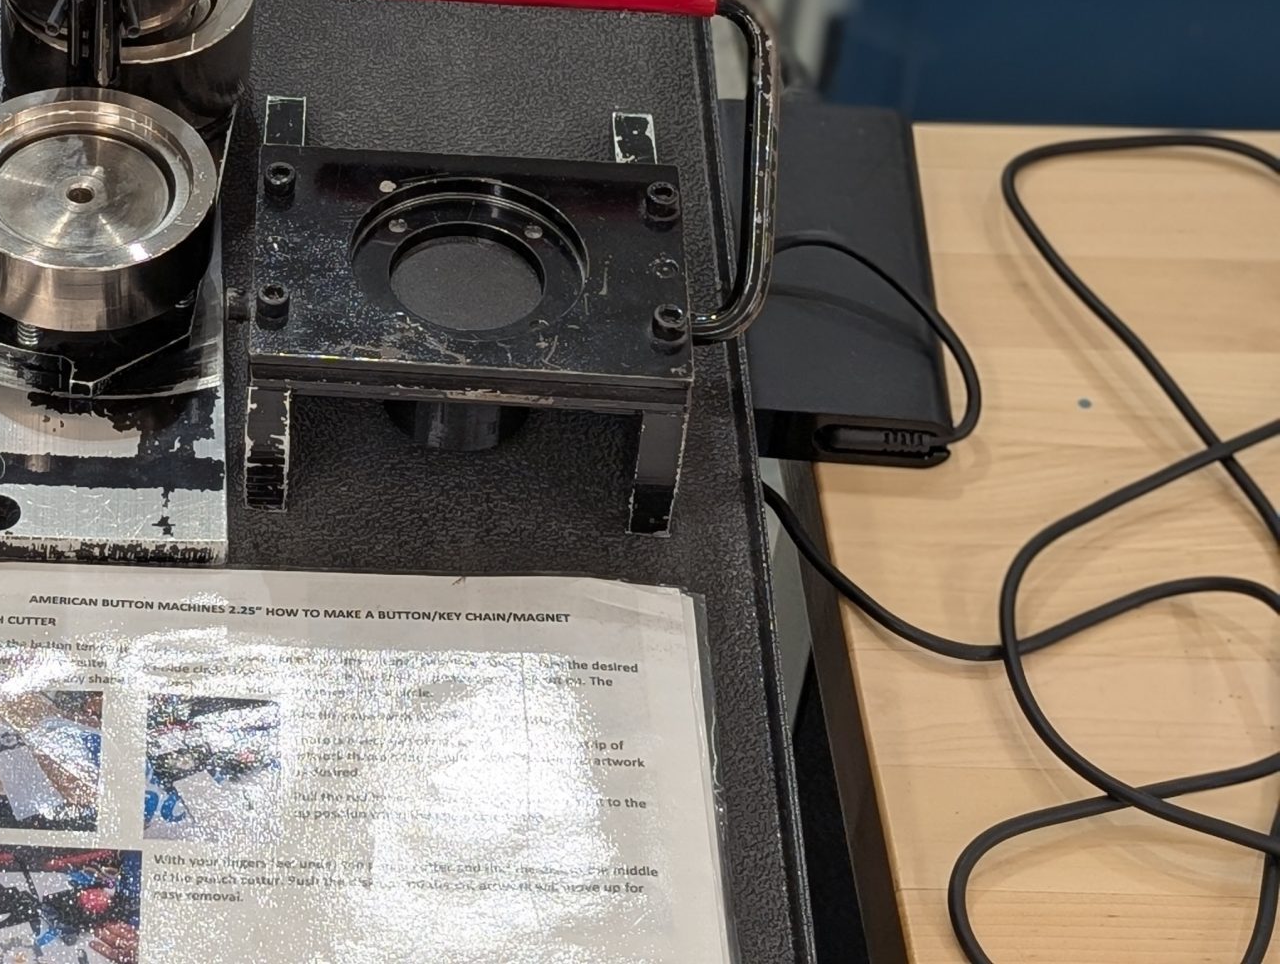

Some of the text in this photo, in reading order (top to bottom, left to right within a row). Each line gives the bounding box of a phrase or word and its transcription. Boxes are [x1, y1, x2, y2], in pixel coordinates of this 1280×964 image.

[28, 594, 98, 607] AMERICAN
[101, 598, 154, 610] BUTTON
[157, 600, 226, 614] MACHINES
[265, 607, 299, 619] HOW
[301, 608, 321, 619] TO
[323, 609, 362, 621] MAKE
[365, 610, 375, 620] A
[378, 610, 463, 623] BUTTON/KEY
[465, 611, 571, 624] CHAIN/MAGNET
[7, 614, 57, 627] CUTTER
[591, 660, 638, 673] desired
[589, 676, 614, 687] The
[610, 739, 625, 751] of
[592, 756, 646, 768] artwork
[607, 797, 621, 808] to
[624, 798, 647, 809] the
[153, 854, 186, 866] With
[613, 865, 659, 877] middle
[603, 883, 621, 894] up
[624, 882, 645, 894] for
